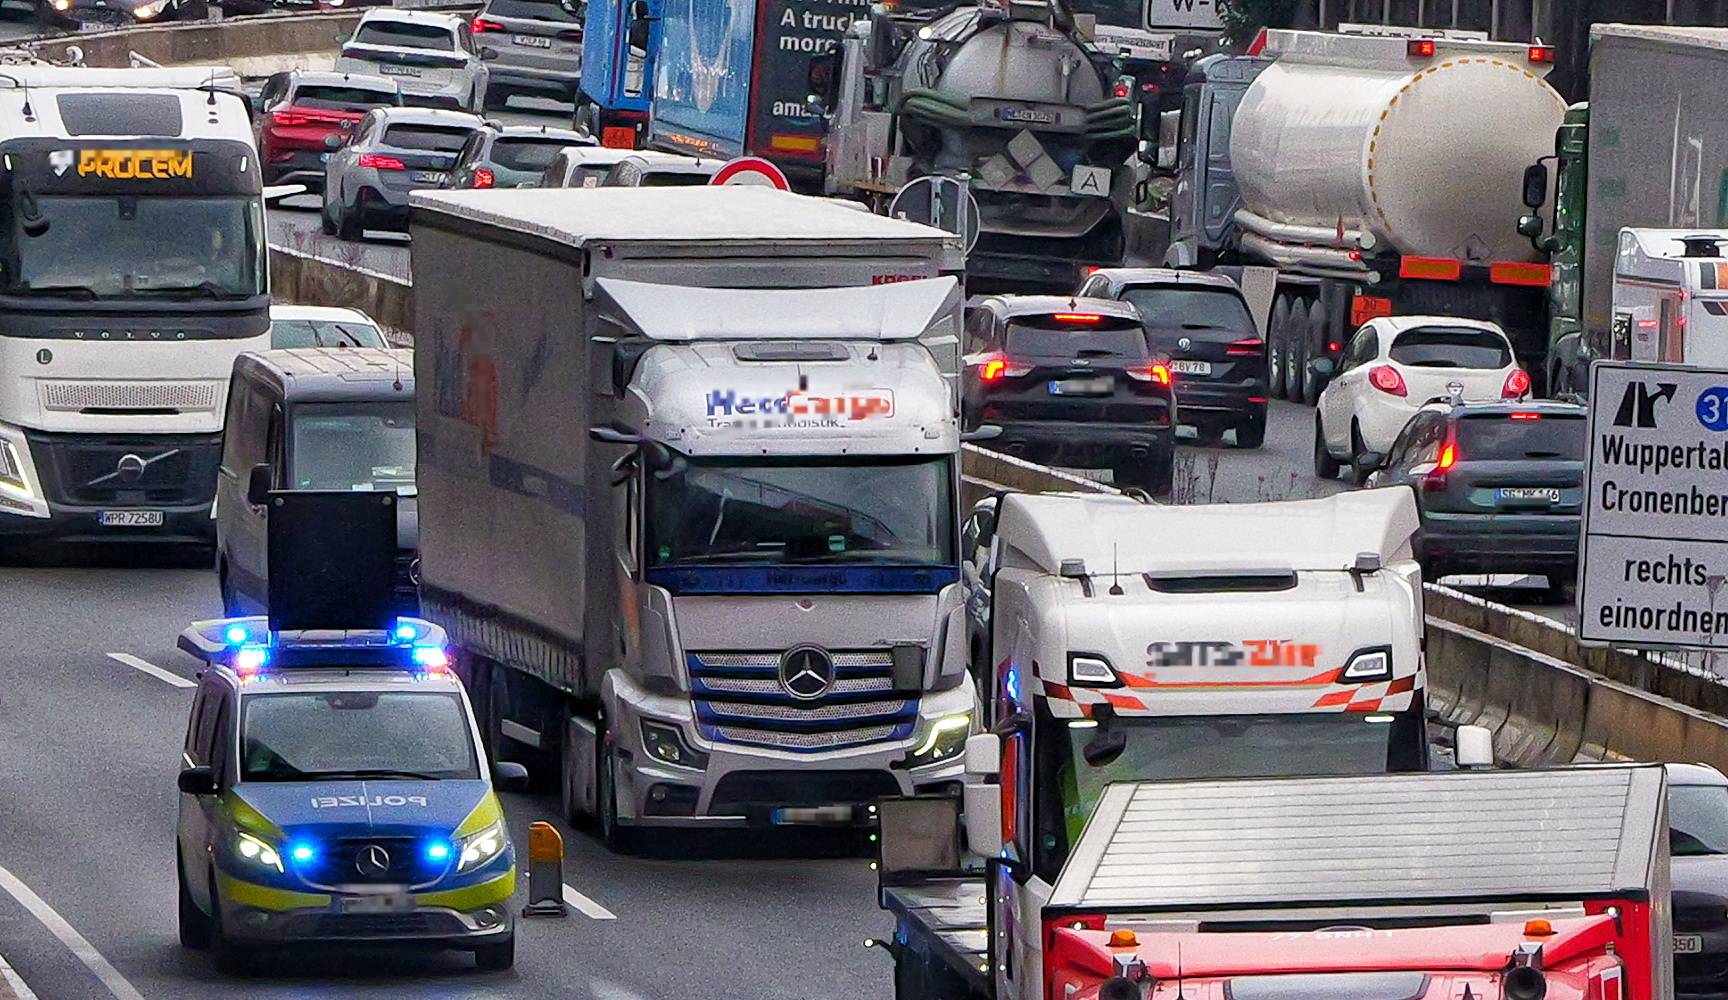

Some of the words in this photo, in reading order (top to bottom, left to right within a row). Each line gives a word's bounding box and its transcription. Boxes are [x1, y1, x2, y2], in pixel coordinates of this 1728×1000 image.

[780, 8, 796, 27] A
[1080, 171, 1099, 192] A
[75, 331, 185, 339] VOLVO
[105, 512, 126, 523] WPR
[1624, 553, 1707, 586] rechts
[1600, 597, 1728, 635] einordnen
